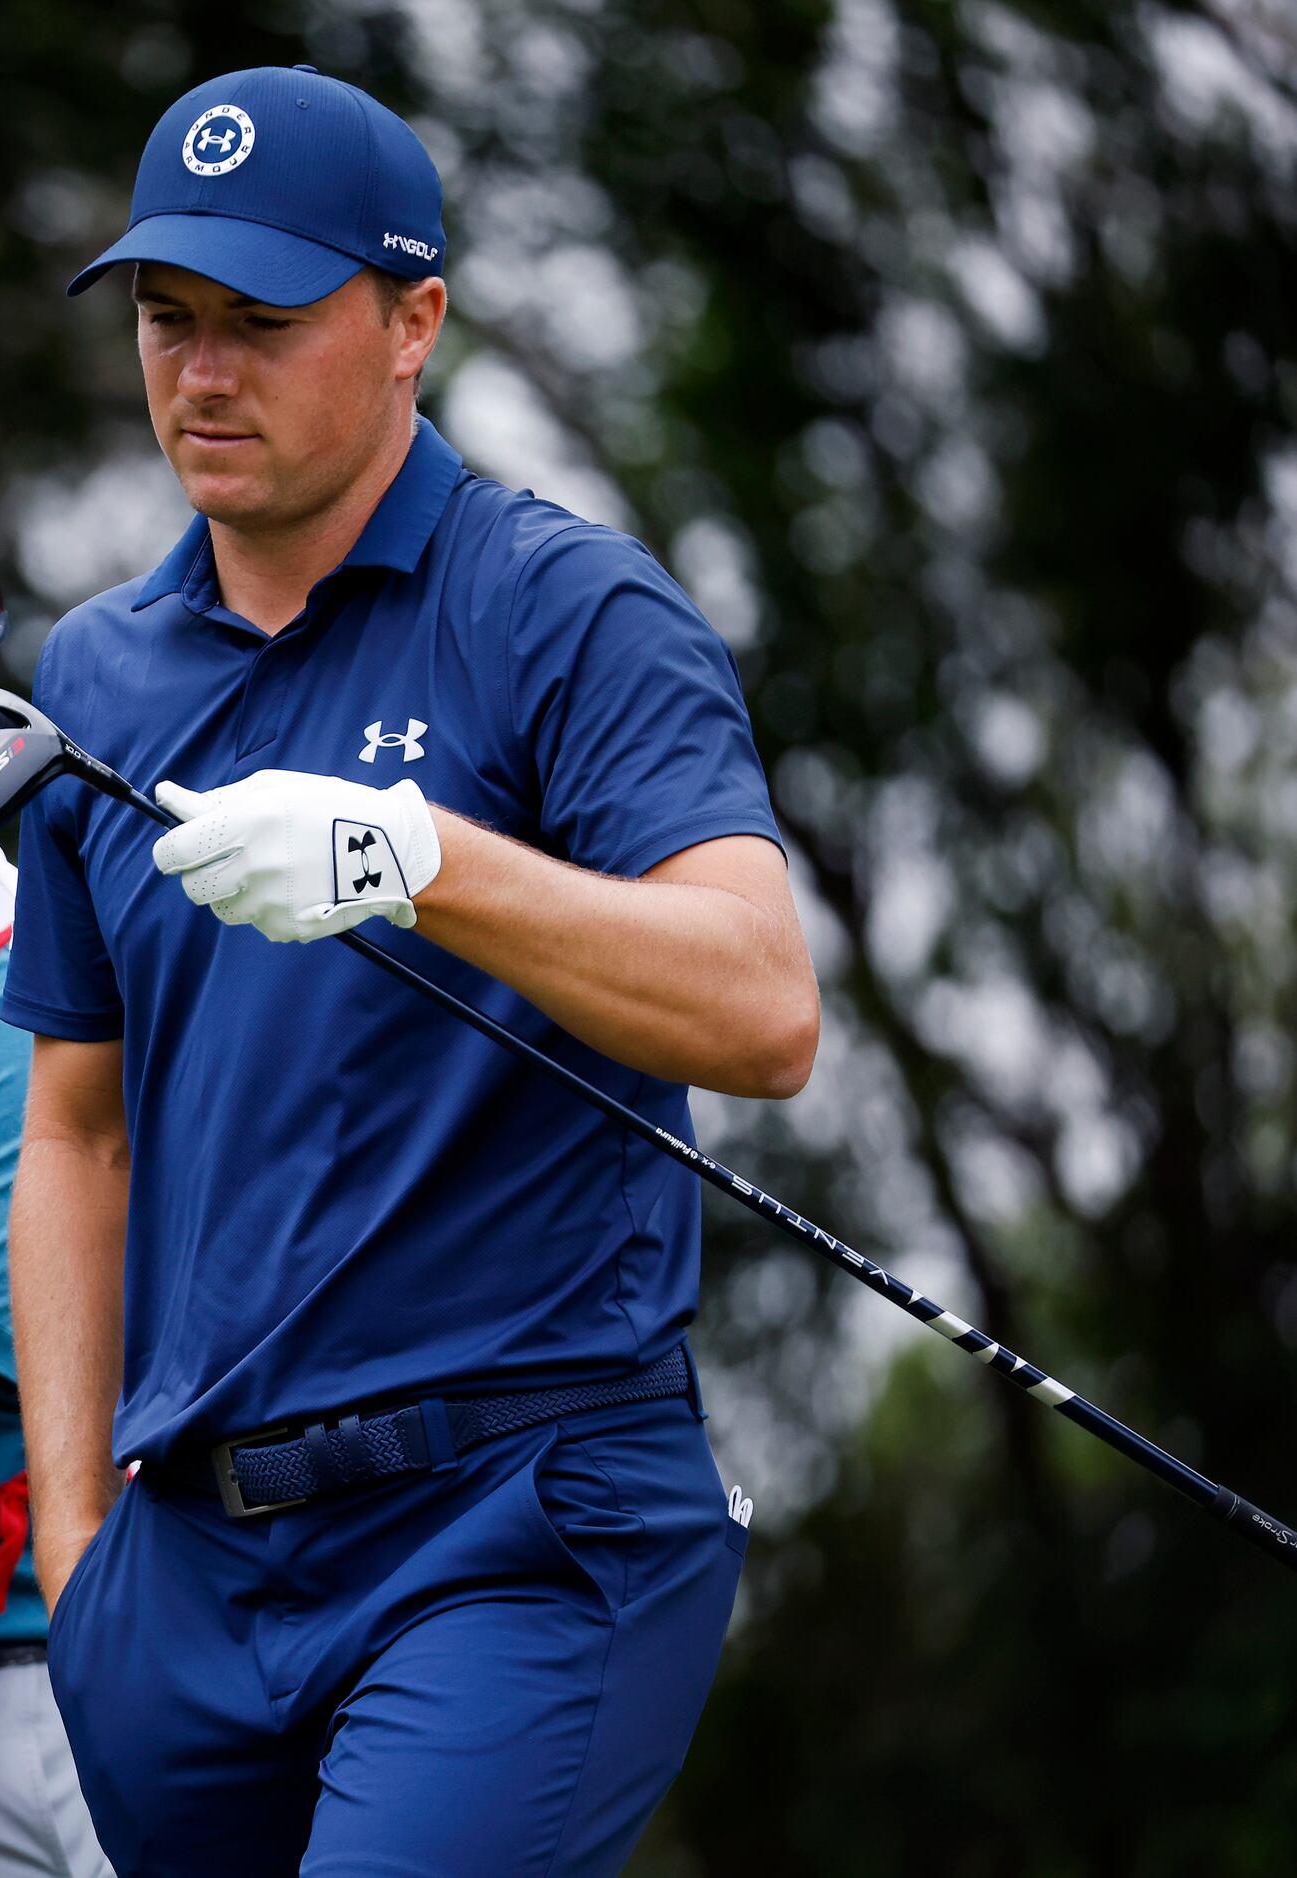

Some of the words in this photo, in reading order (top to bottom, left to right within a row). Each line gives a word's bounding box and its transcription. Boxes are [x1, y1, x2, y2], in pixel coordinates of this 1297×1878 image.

[191, 106, 252, 135] UNDER
[184, 141, 251, 173] ARMOUR
[731, 1174, 890, 1286] VENTUS
